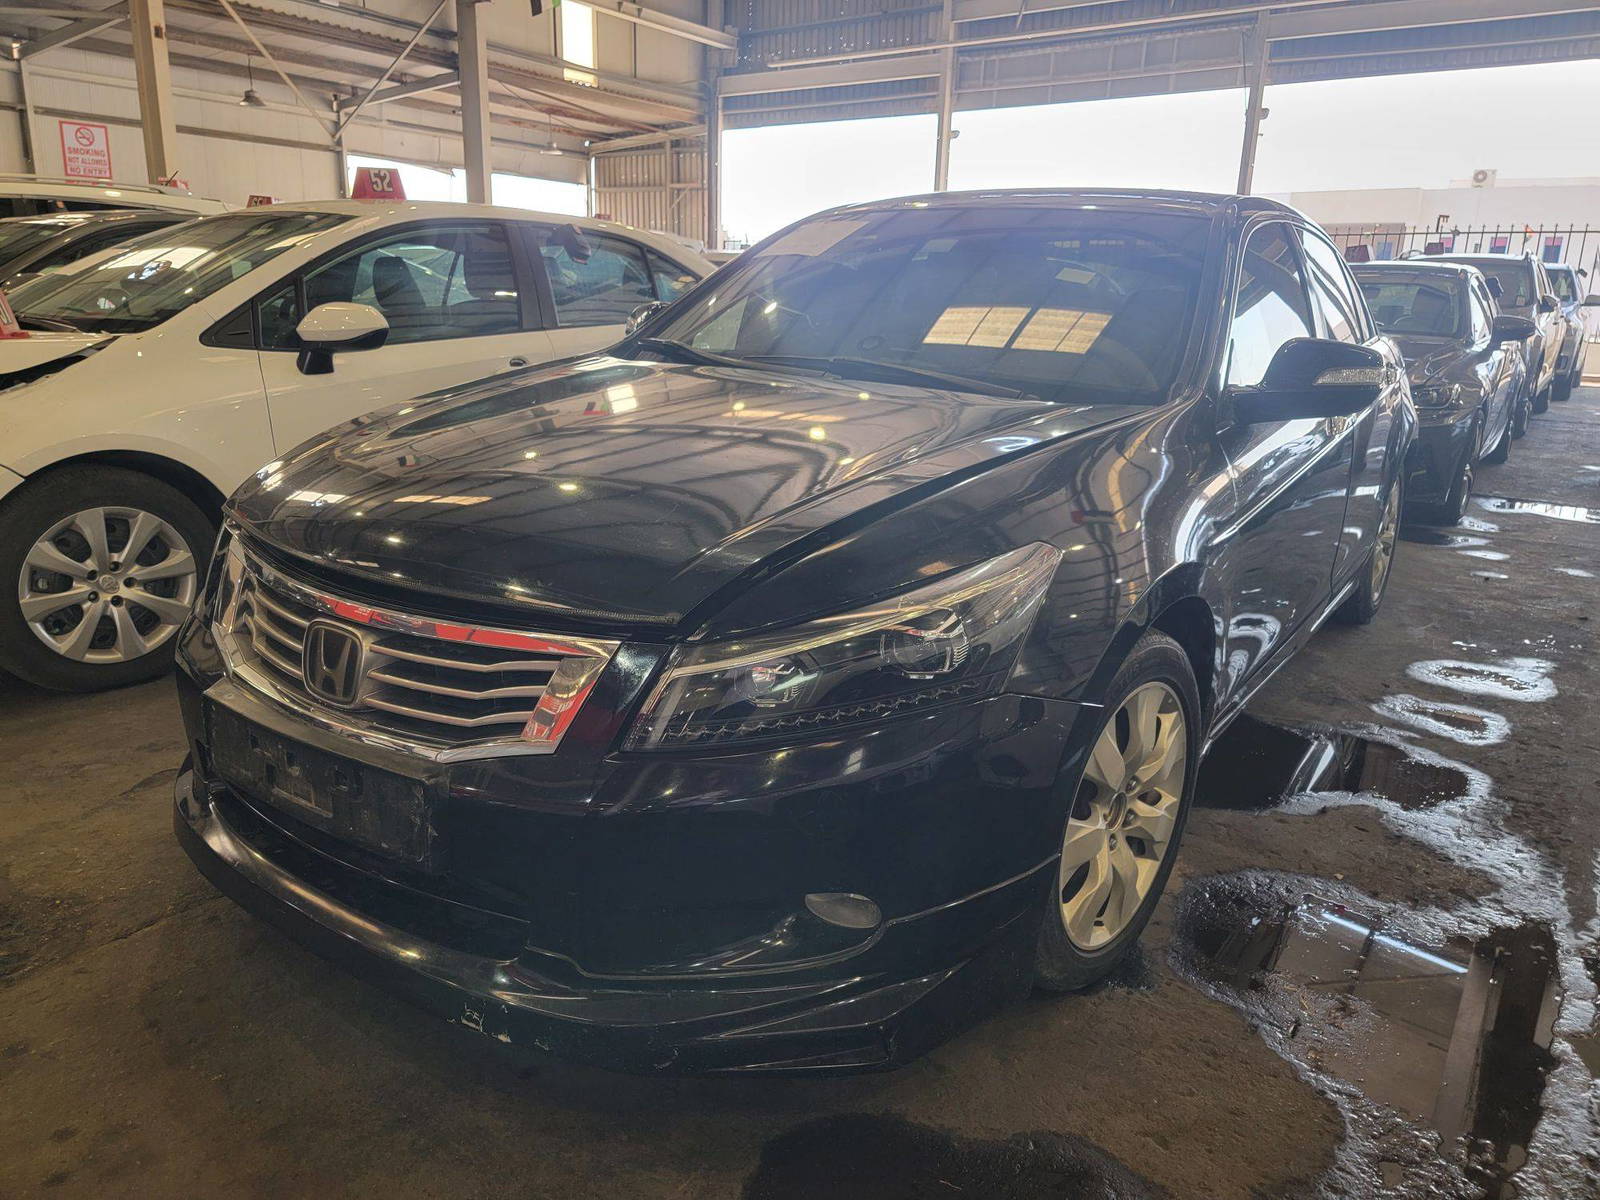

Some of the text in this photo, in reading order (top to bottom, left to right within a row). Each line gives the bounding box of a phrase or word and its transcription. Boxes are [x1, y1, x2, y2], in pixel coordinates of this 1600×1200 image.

[67, 146, 106, 158] SMOKING
[83, 167, 108, 176] ENTRY
[369, 169, 393, 192] 52
